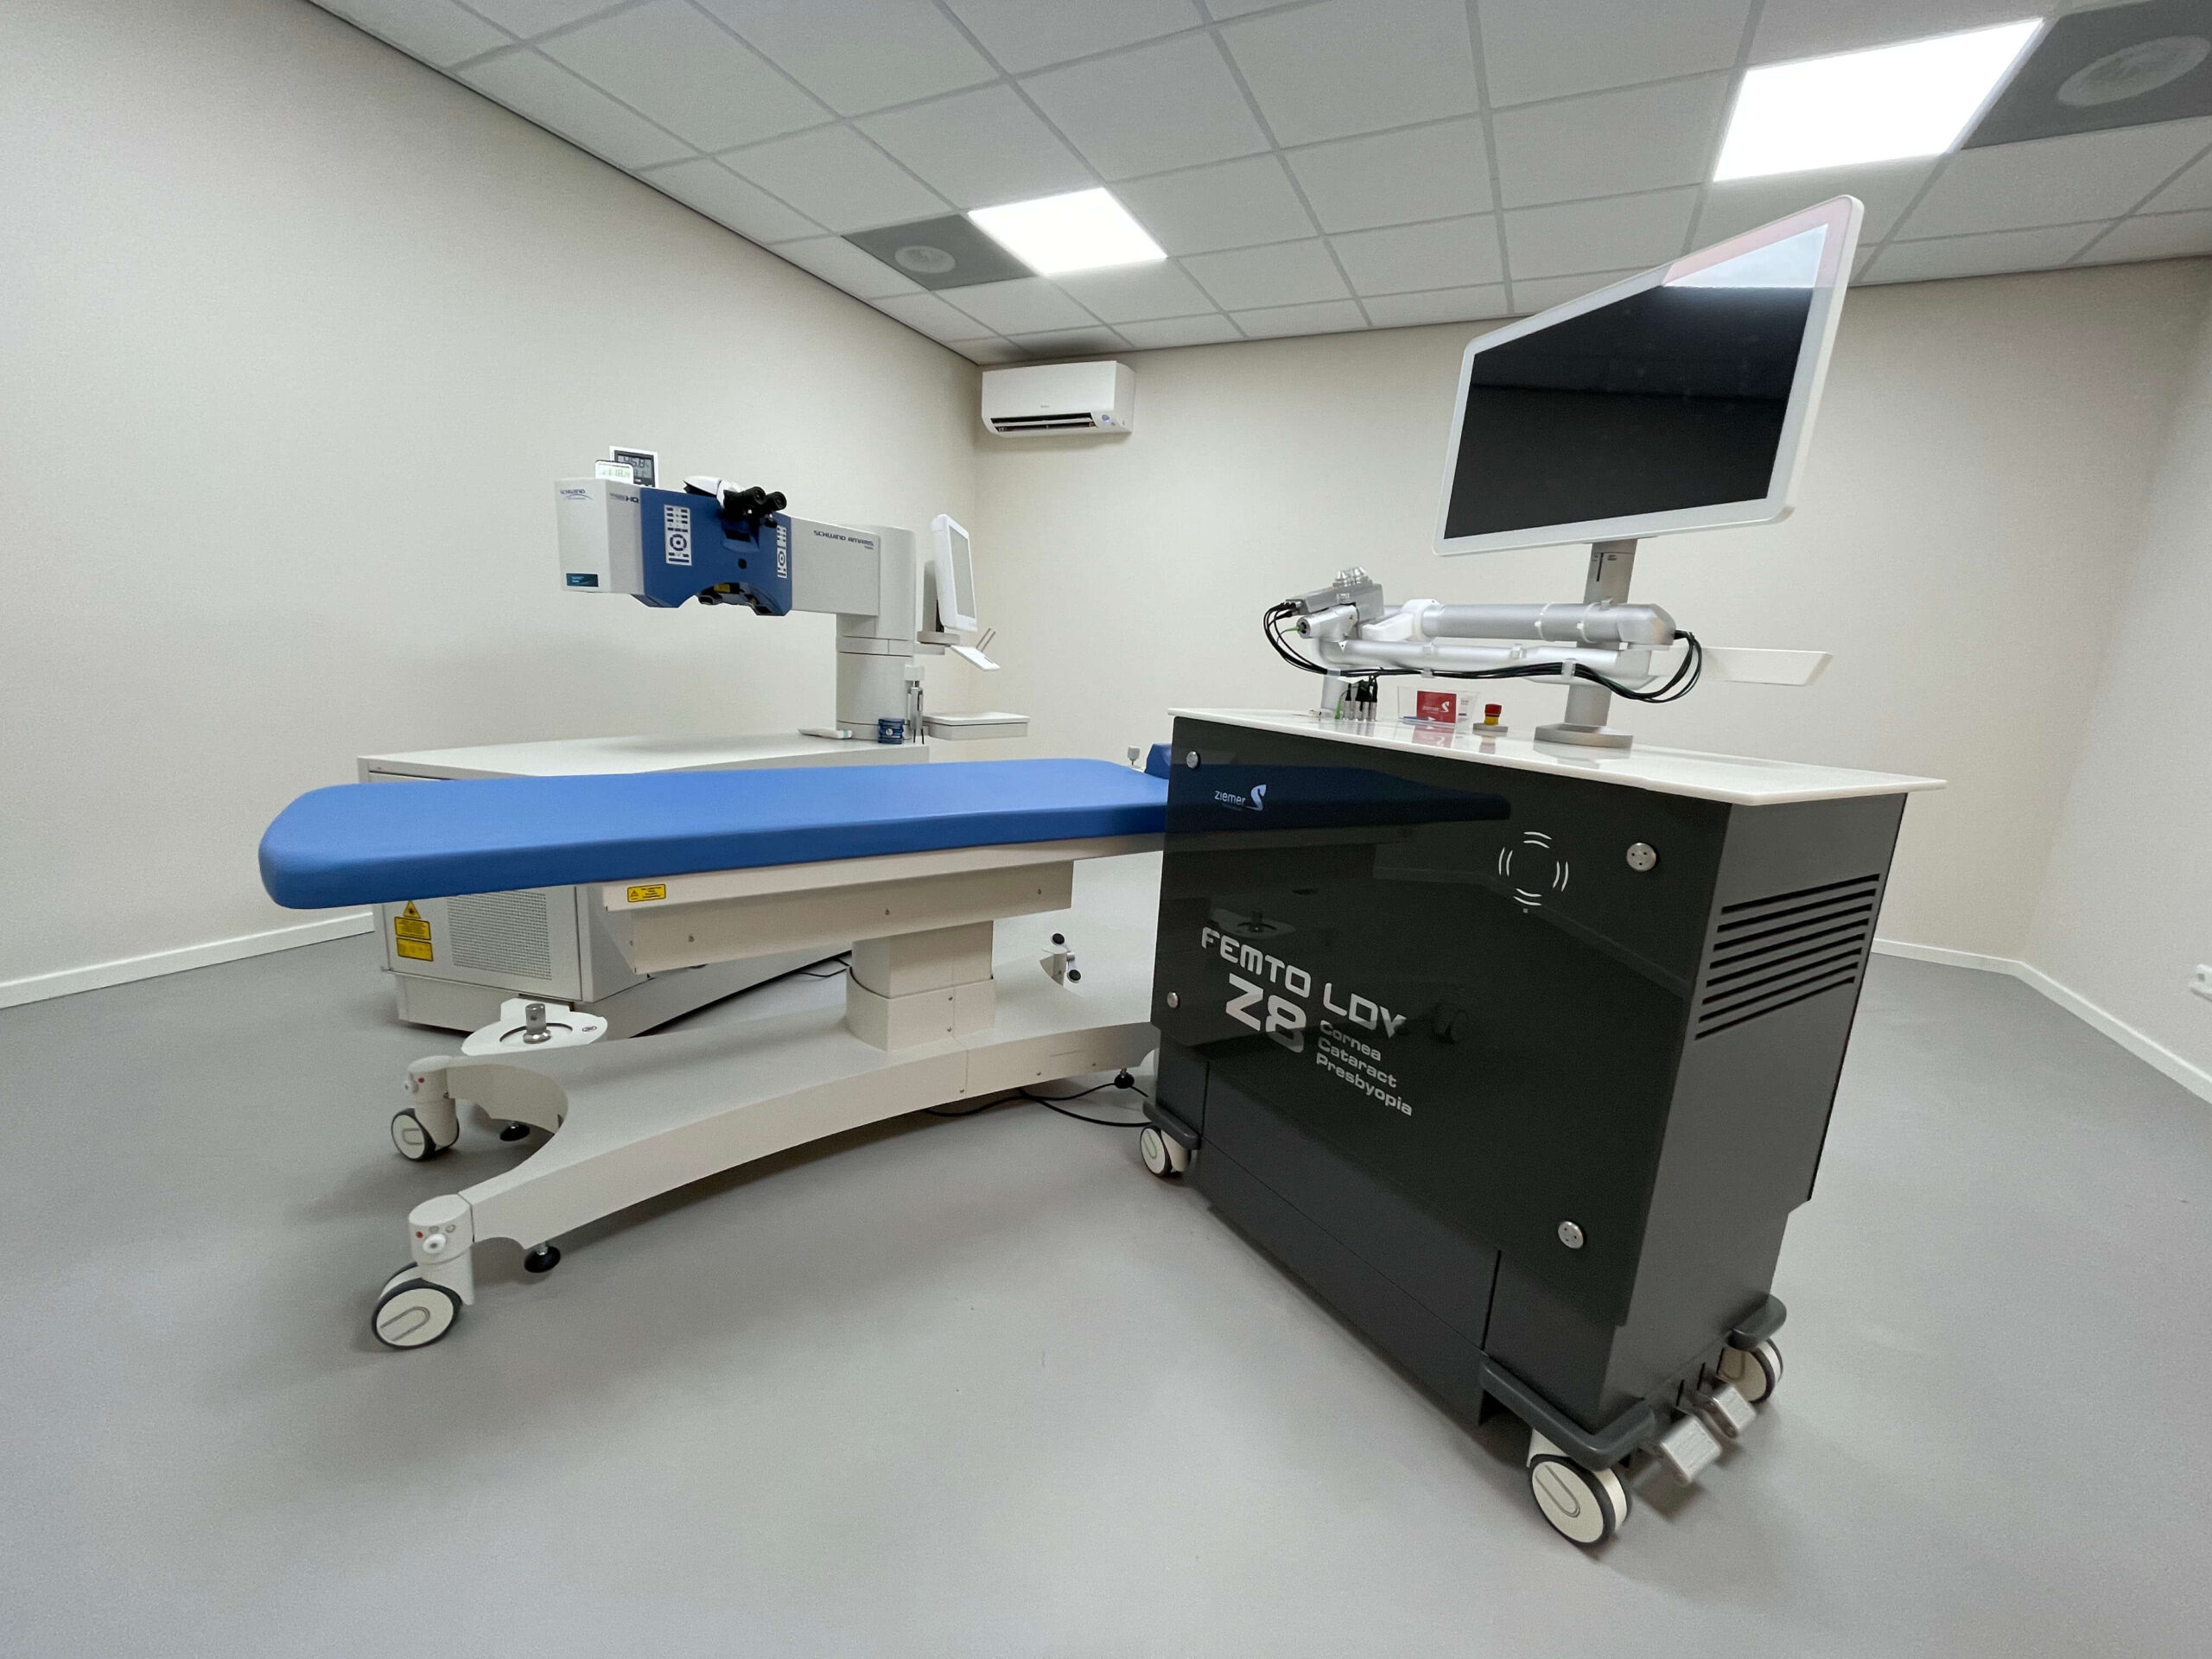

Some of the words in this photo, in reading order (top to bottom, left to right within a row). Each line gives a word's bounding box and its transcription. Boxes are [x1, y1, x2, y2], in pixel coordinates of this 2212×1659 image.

[813, 530, 846, 541] SCHWIND
[1214, 790, 1246, 805] ziemer
[1201, 926, 1312, 998] FEMTO
[1323, 982, 1407, 1038] LDV
[1225, 972, 1307, 1053] Z8
[1318, 1036, 1397, 1088] Cataract
[1320, 1020, 1382, 1062] Cornea
[1316, 1052, 1413, 1116] Presbyopia
